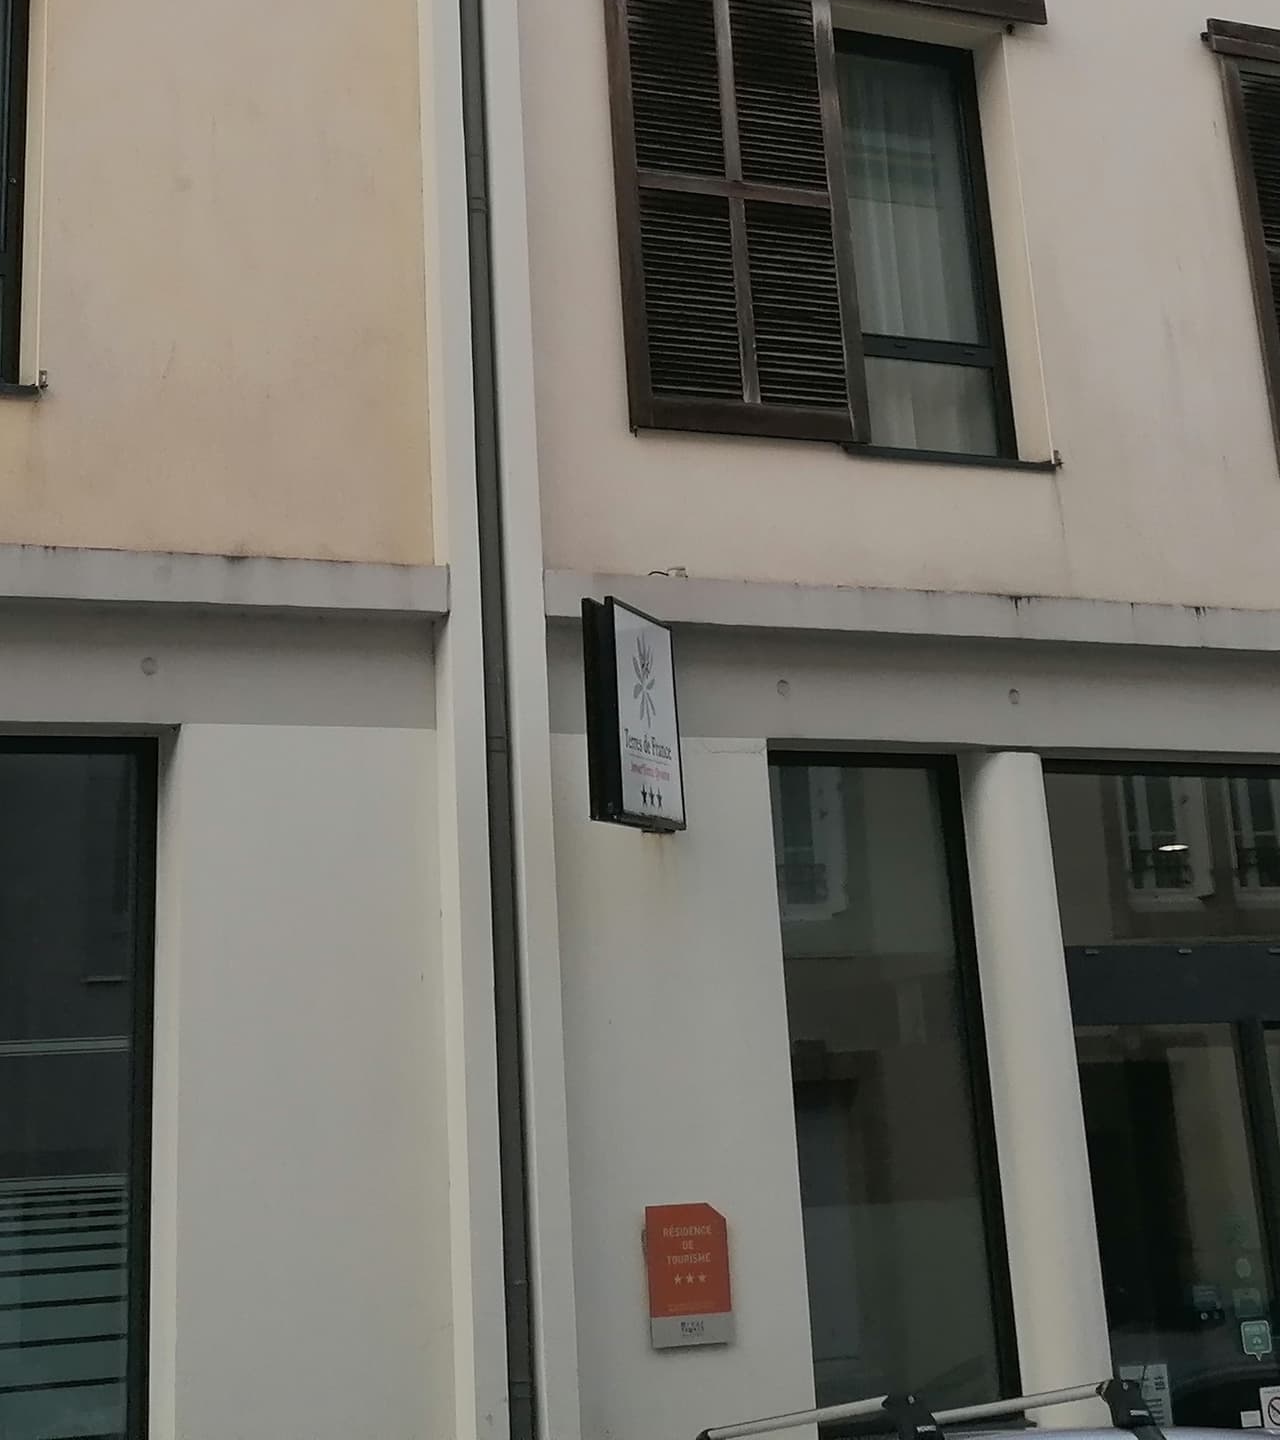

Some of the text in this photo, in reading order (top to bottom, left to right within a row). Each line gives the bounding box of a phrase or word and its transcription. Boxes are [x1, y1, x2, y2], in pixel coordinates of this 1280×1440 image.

[624, 728, 672, 760] Terres de France
[682, 1240, 695, 1250] DE
[667, 1252, 711, 1265] TOURISME
